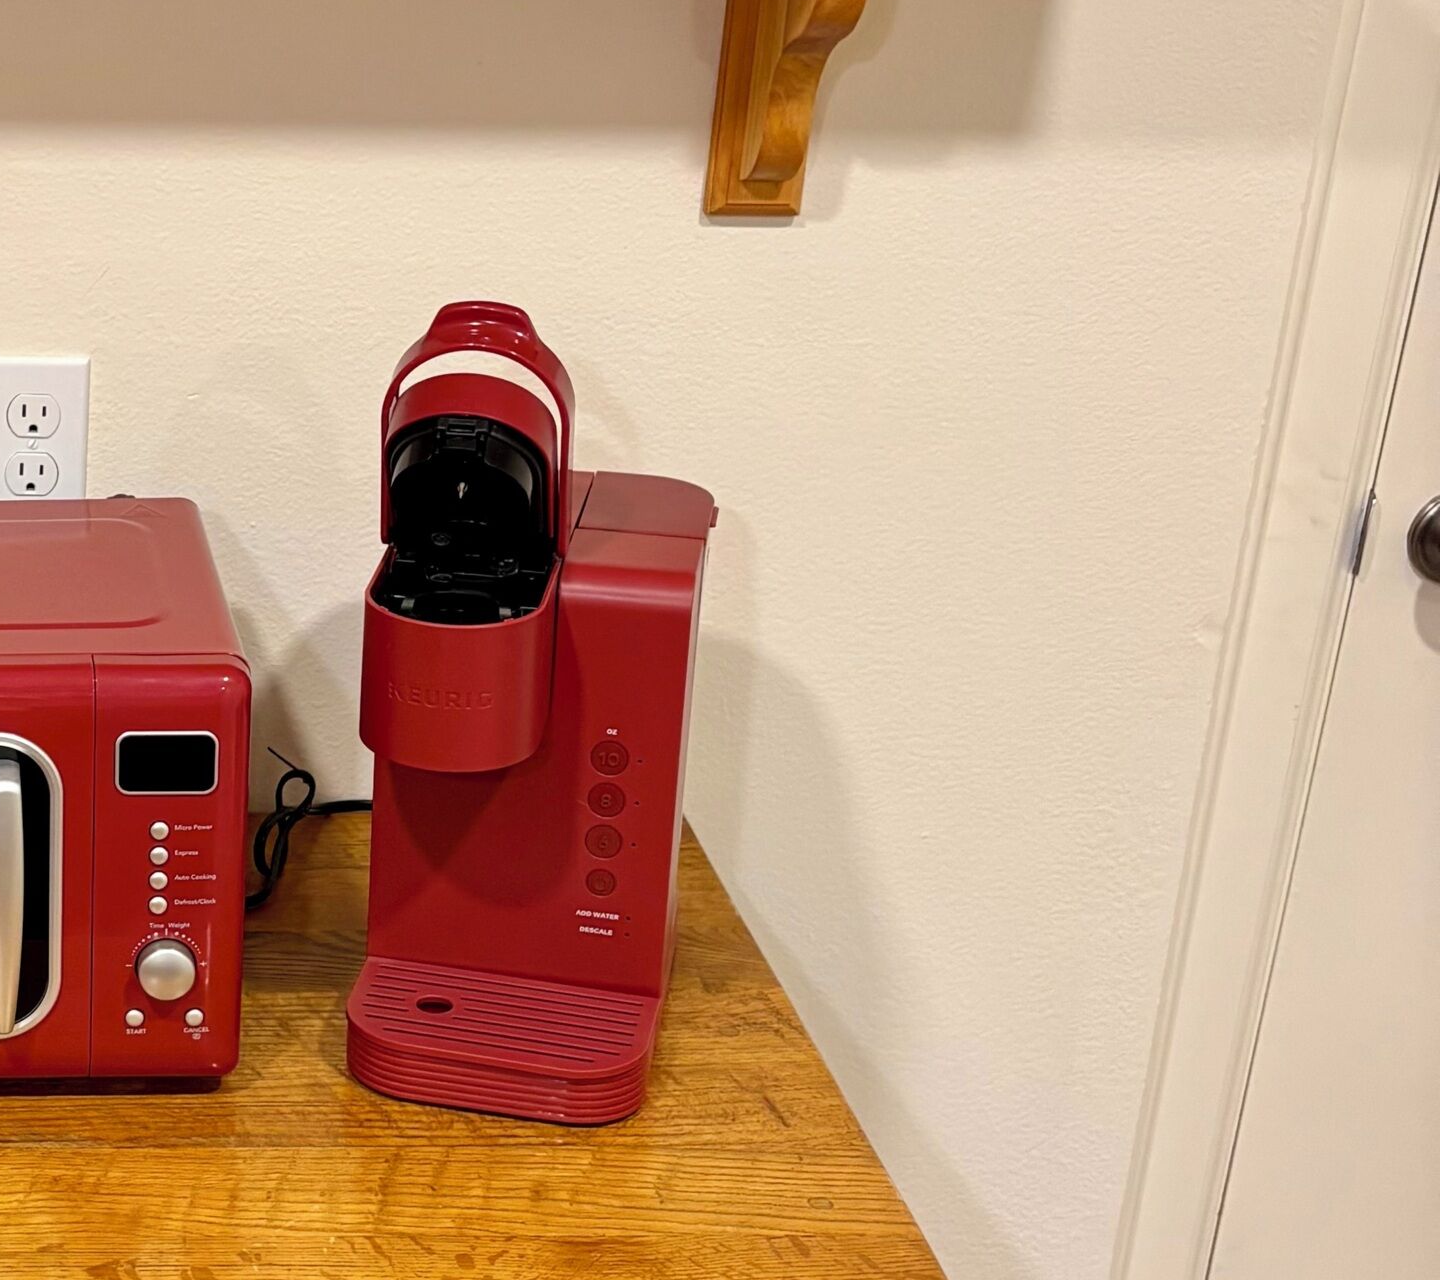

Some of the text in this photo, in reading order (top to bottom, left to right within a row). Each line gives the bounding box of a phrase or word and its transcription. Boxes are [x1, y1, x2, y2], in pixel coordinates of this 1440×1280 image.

[388, 682, 493, 711] KEURIG
[598, 751, 620, 767] 10
[600, 793, 612, 808] 8
[191, 873, 217, 881] Cooking
[575, 909, 620, 921] ADD WATER
[579, 926, 613, 936] DESCALE
